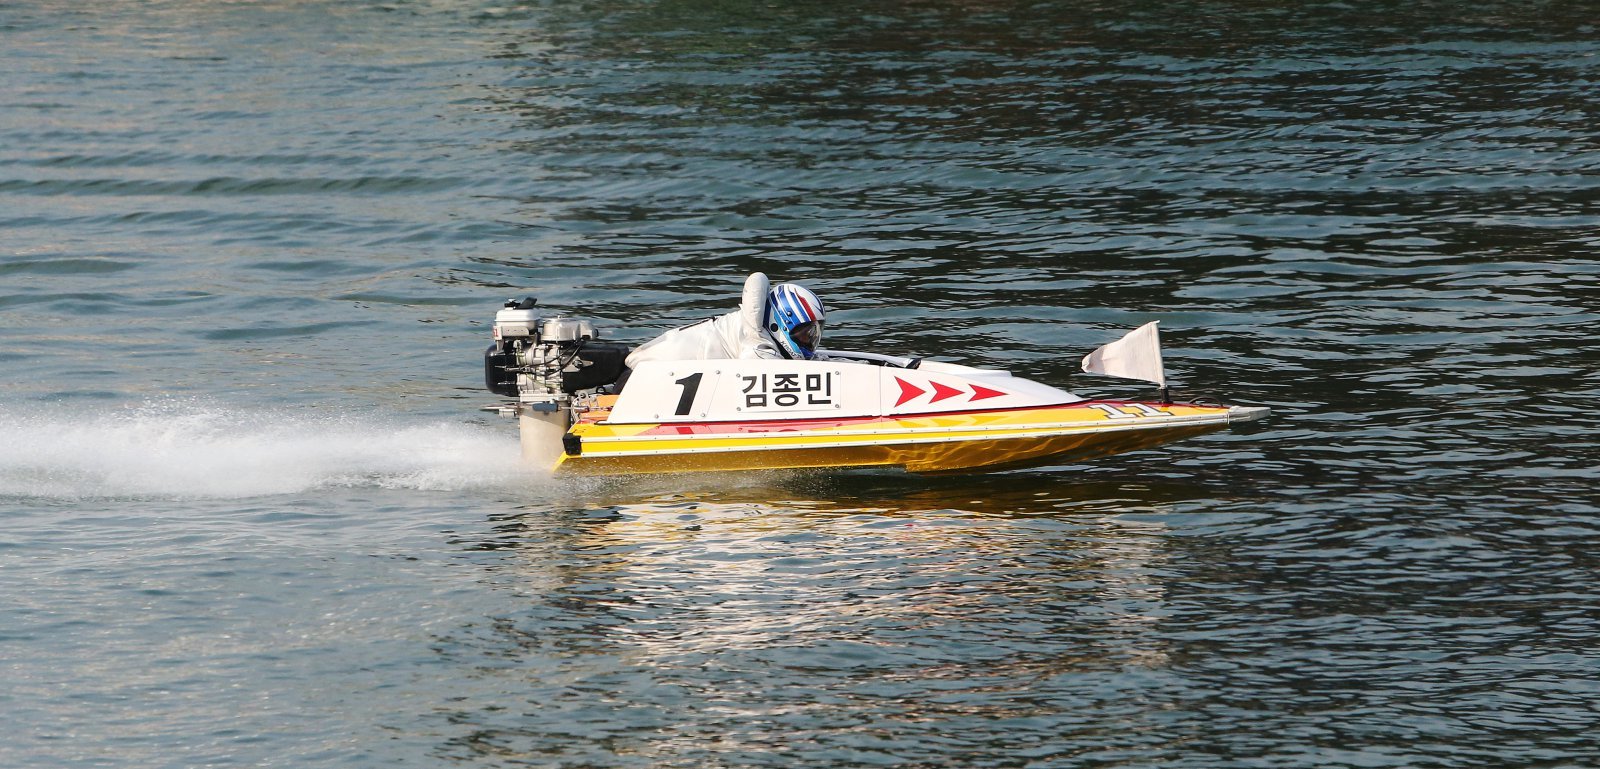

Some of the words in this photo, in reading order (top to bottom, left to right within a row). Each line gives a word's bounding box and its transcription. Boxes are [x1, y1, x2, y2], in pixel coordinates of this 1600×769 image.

[674, 372, 704, 416] 1
[741, 372, 832, 408] 김종민
[1088, 403, 1175, 419] 11
